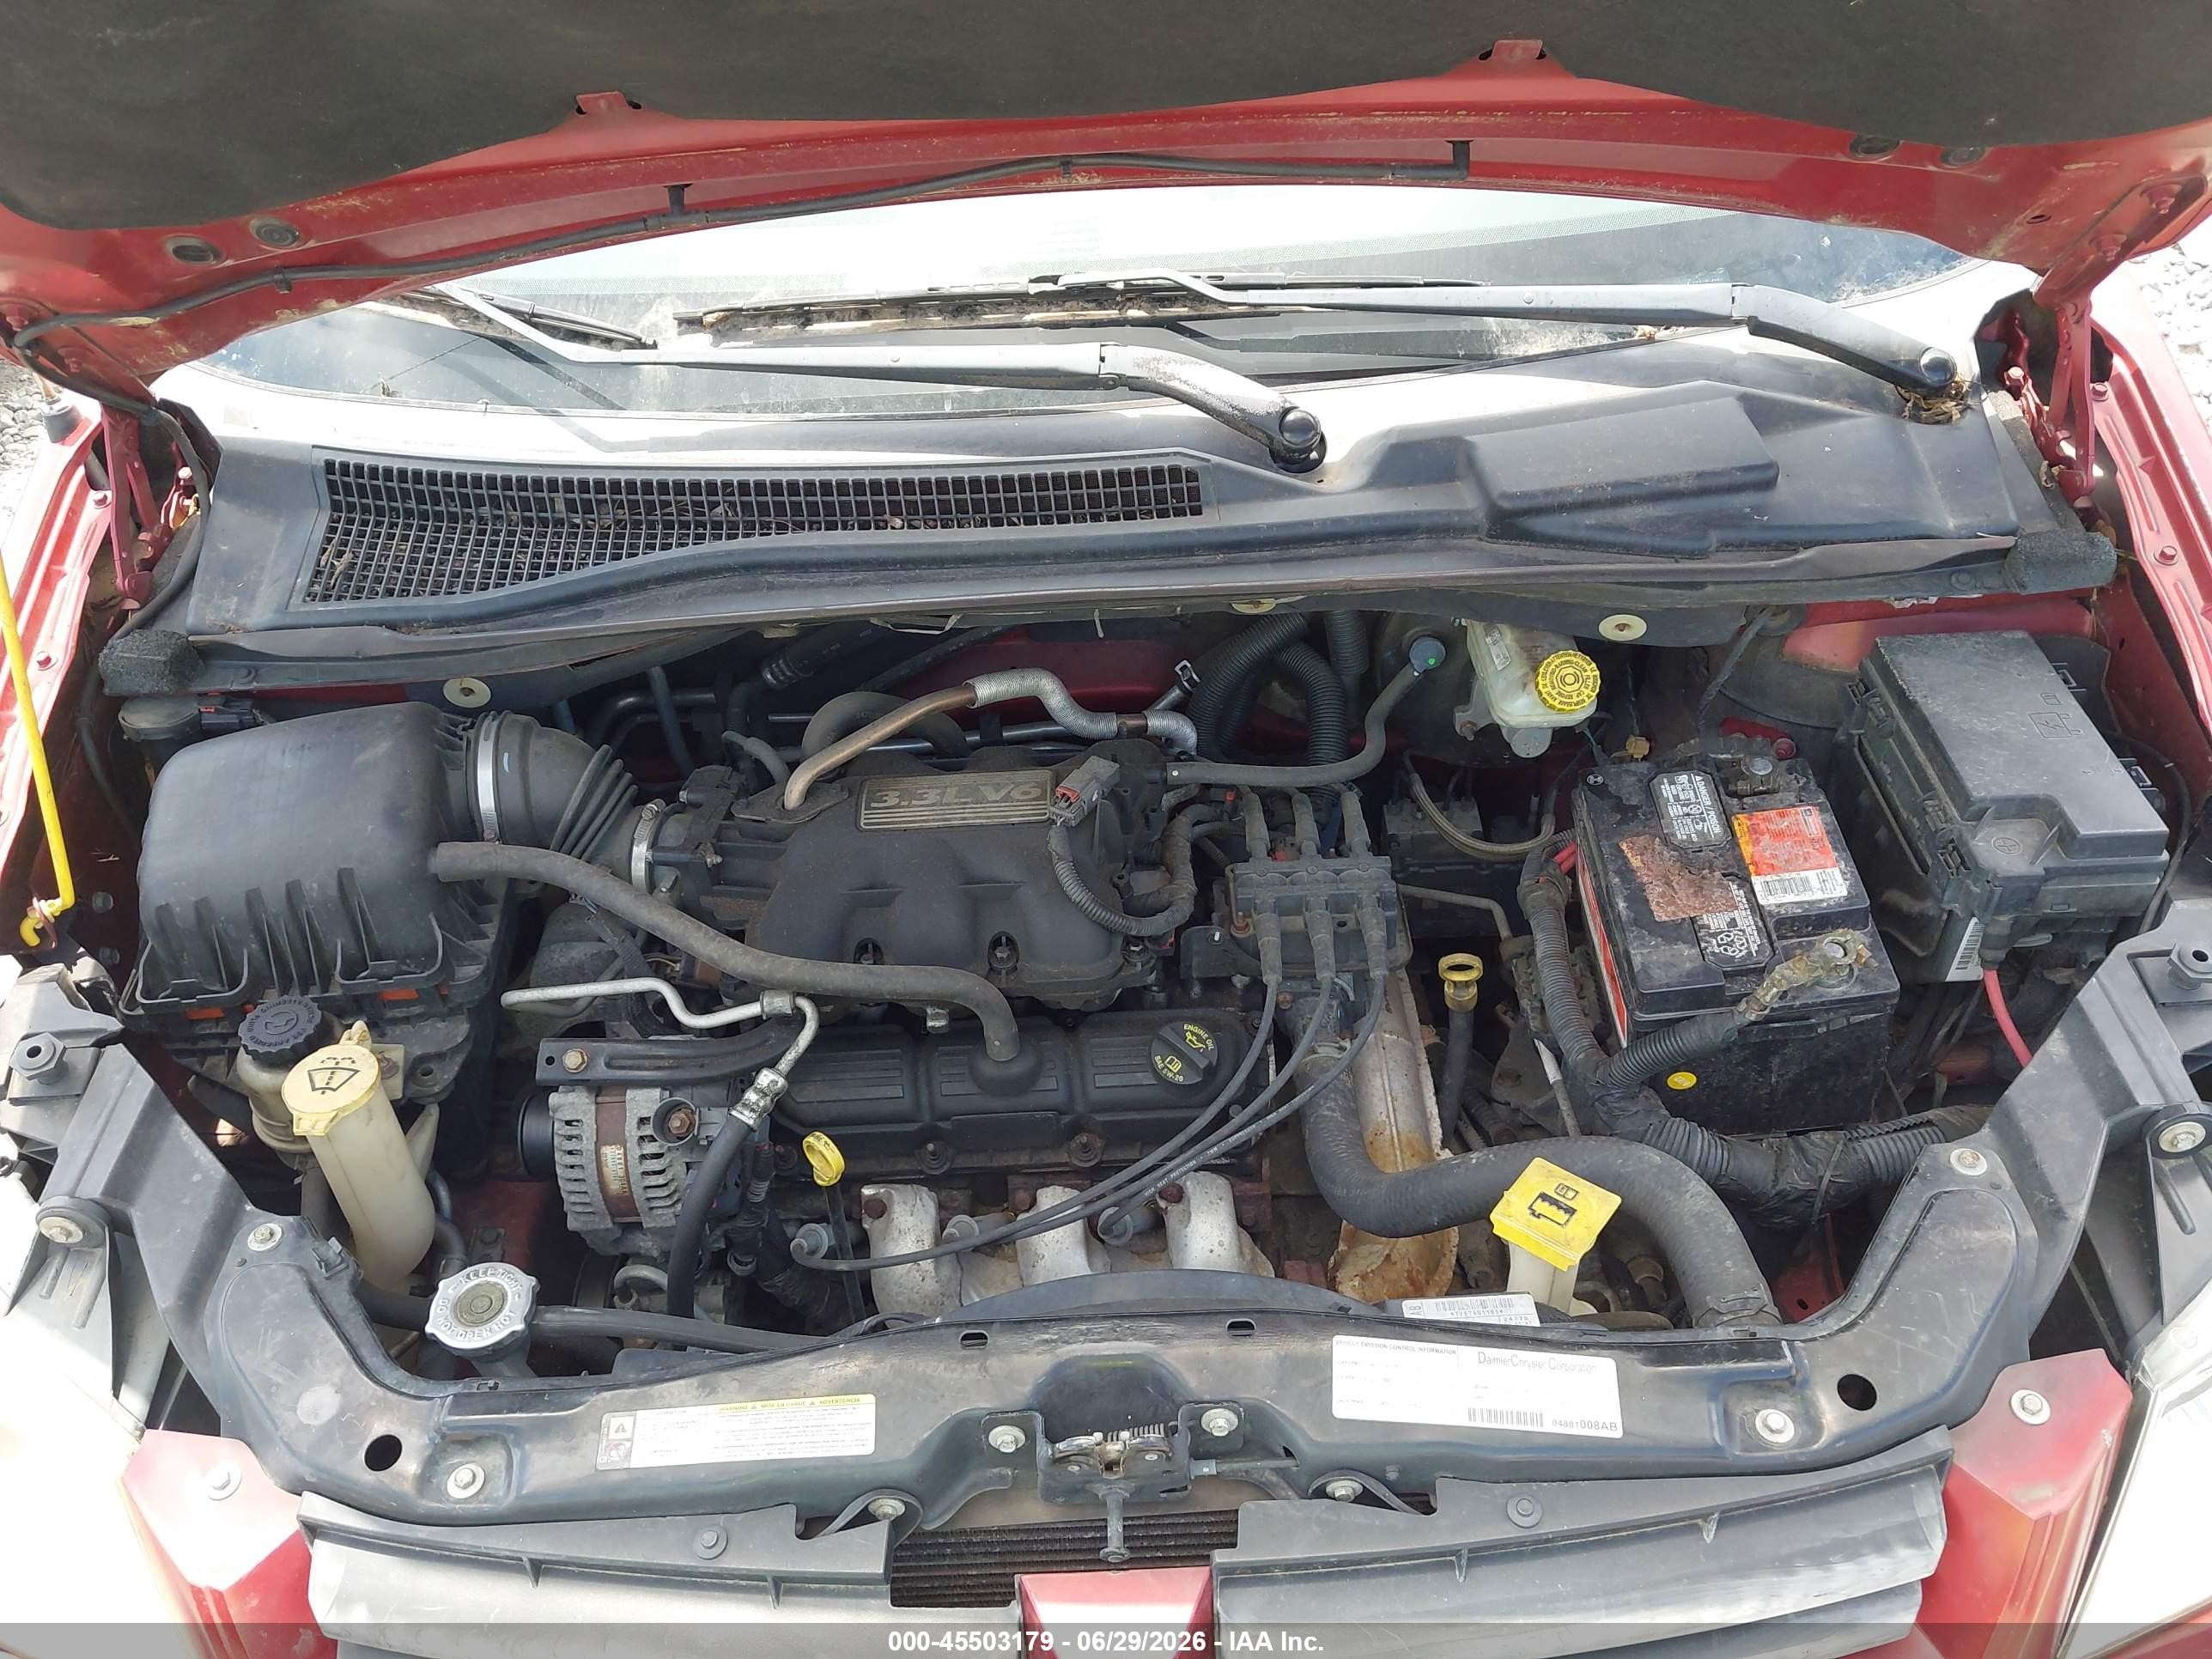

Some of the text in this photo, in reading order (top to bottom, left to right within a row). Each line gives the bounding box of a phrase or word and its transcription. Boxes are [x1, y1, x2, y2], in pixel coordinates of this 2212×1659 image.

[870, 782, 1042, 808] 3.3L V6
[1696, 781, 1711, 805] DANGER
[1707, 810, 1722, 833] POISON
[1183, 1024, 1215, 1051] ENGINE OIL
[1154, 1055, 1184, 1082] SAE 5W-20
[437, 1297, 449, 1313] DO
[438, 1316, 458, 1334] NOT
[456, 1327, 493, 1340] OPEN
[1478, 1351, 1597, 1374] DaimlerChrysler Corporation
